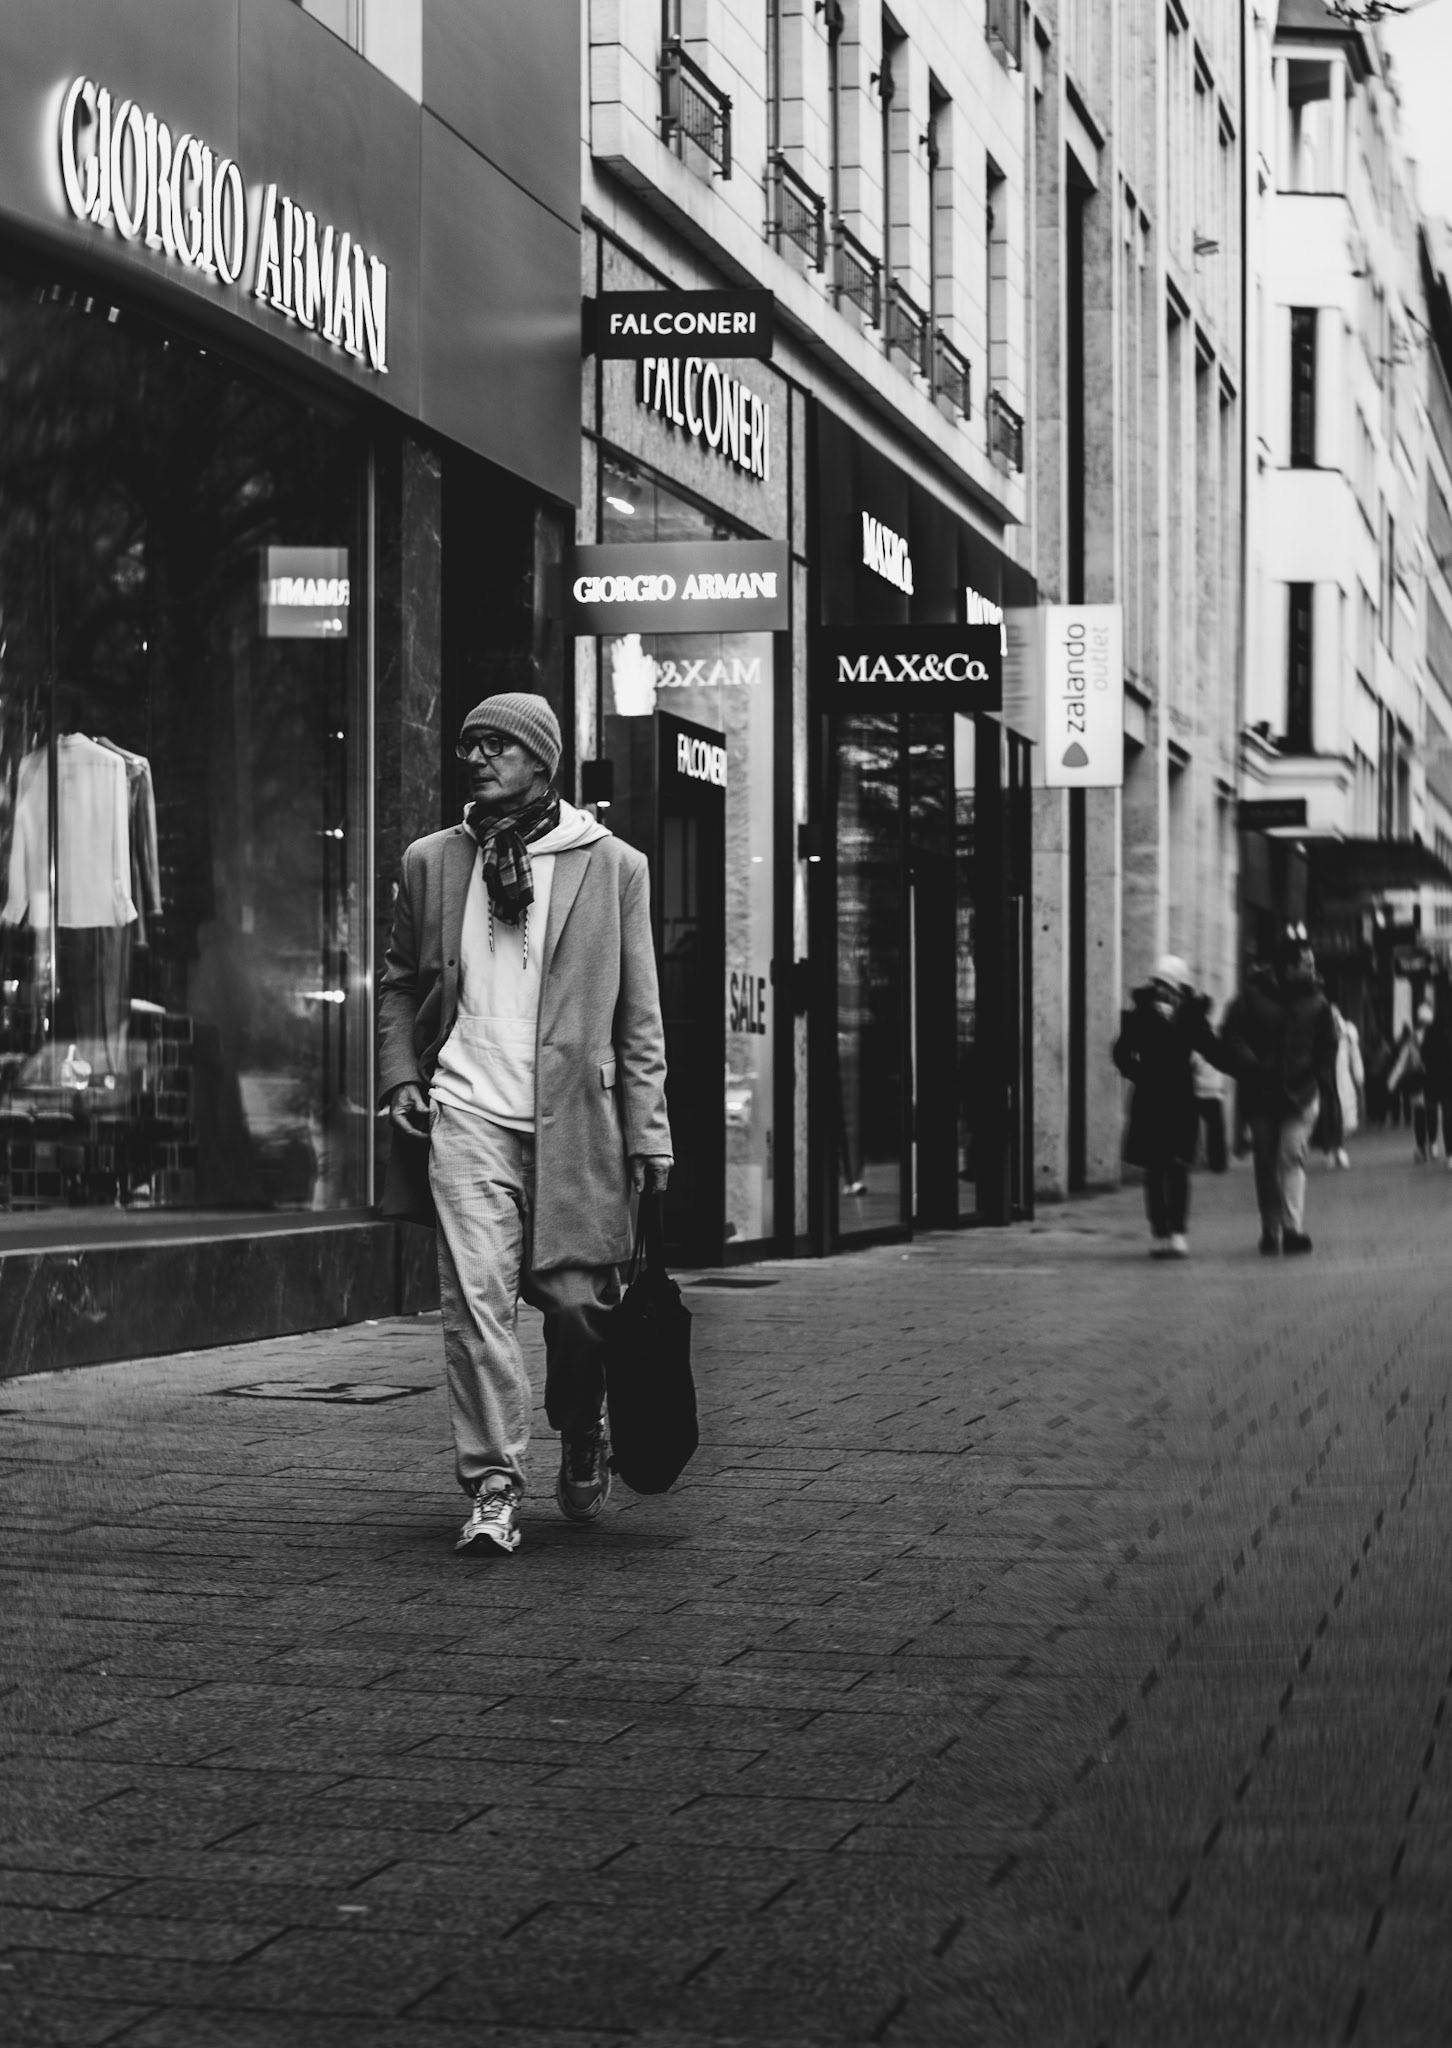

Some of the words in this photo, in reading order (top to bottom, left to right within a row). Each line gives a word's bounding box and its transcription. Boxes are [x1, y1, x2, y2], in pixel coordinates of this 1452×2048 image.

[62, 75, 244, 284] GIORGIO
[255, 183, 388, 373] ARMANI
[610, 312, 757, 335] FALCONERI
[573, 574, 677, 603] GIORGIO
[681, 571, 778, 600] ARMANI
[837, 652, 990, 683] MAX&Co.
[1062, 623, 1086, 734] zalando
[1090, 626, 1109, 692] outlet
[730, 971, 766, 1036] SALE
